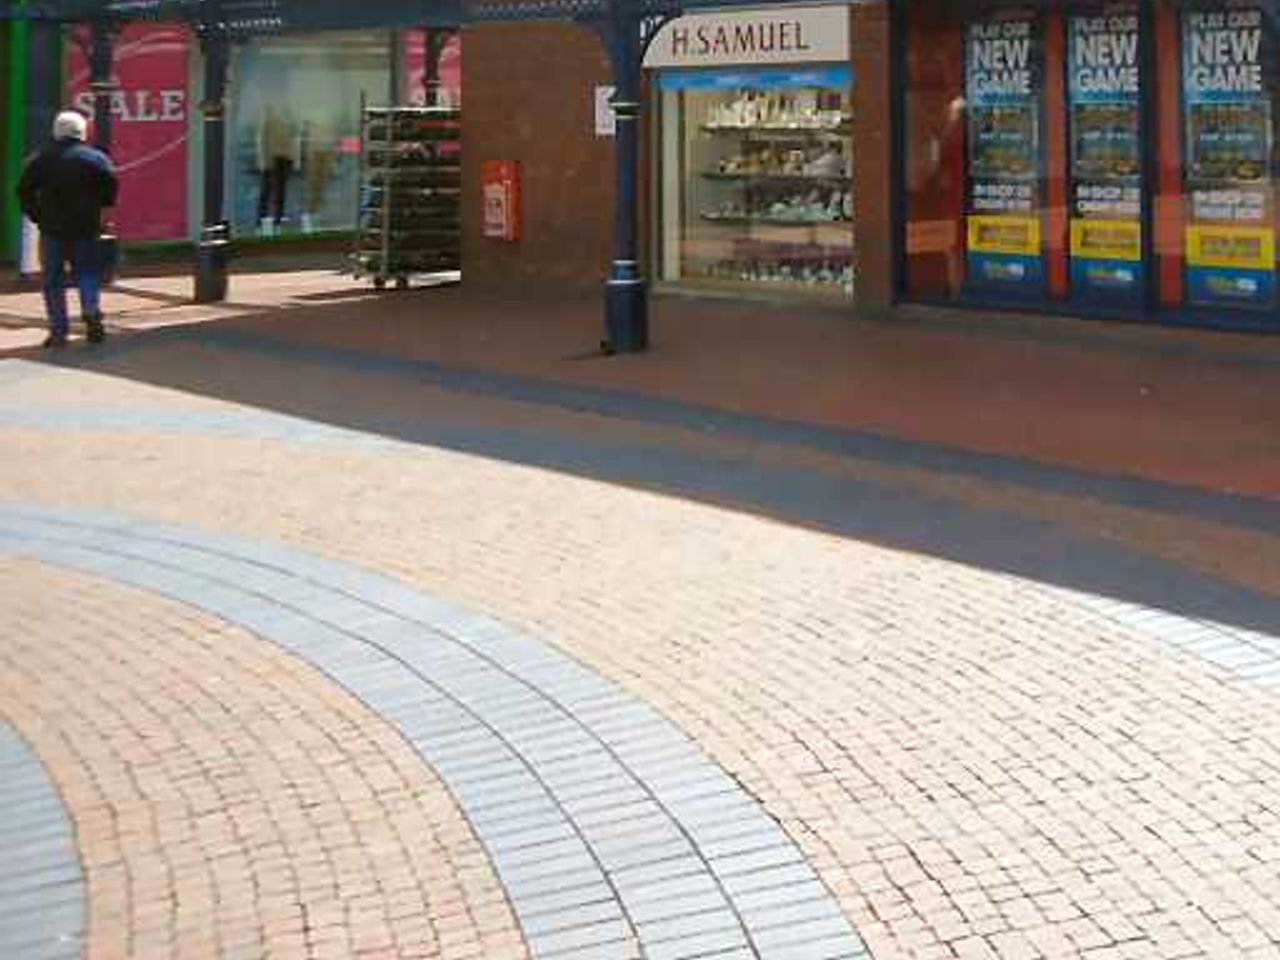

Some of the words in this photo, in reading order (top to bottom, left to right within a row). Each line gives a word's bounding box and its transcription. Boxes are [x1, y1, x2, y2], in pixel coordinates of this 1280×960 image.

[671, 21, 811, 57] H.SAMUEL
[972, 39, 1029, 69] NEW
[1076, 33, 1139, 66] NEW
[1191, 29, 1261, 64] NEW
[973, 70, 1032, 95] GAME
[1077, 67, 1139, 92] GAME
[1192, 65, 1262, 91] GAME
[73, 90, 185, 122] SALE
